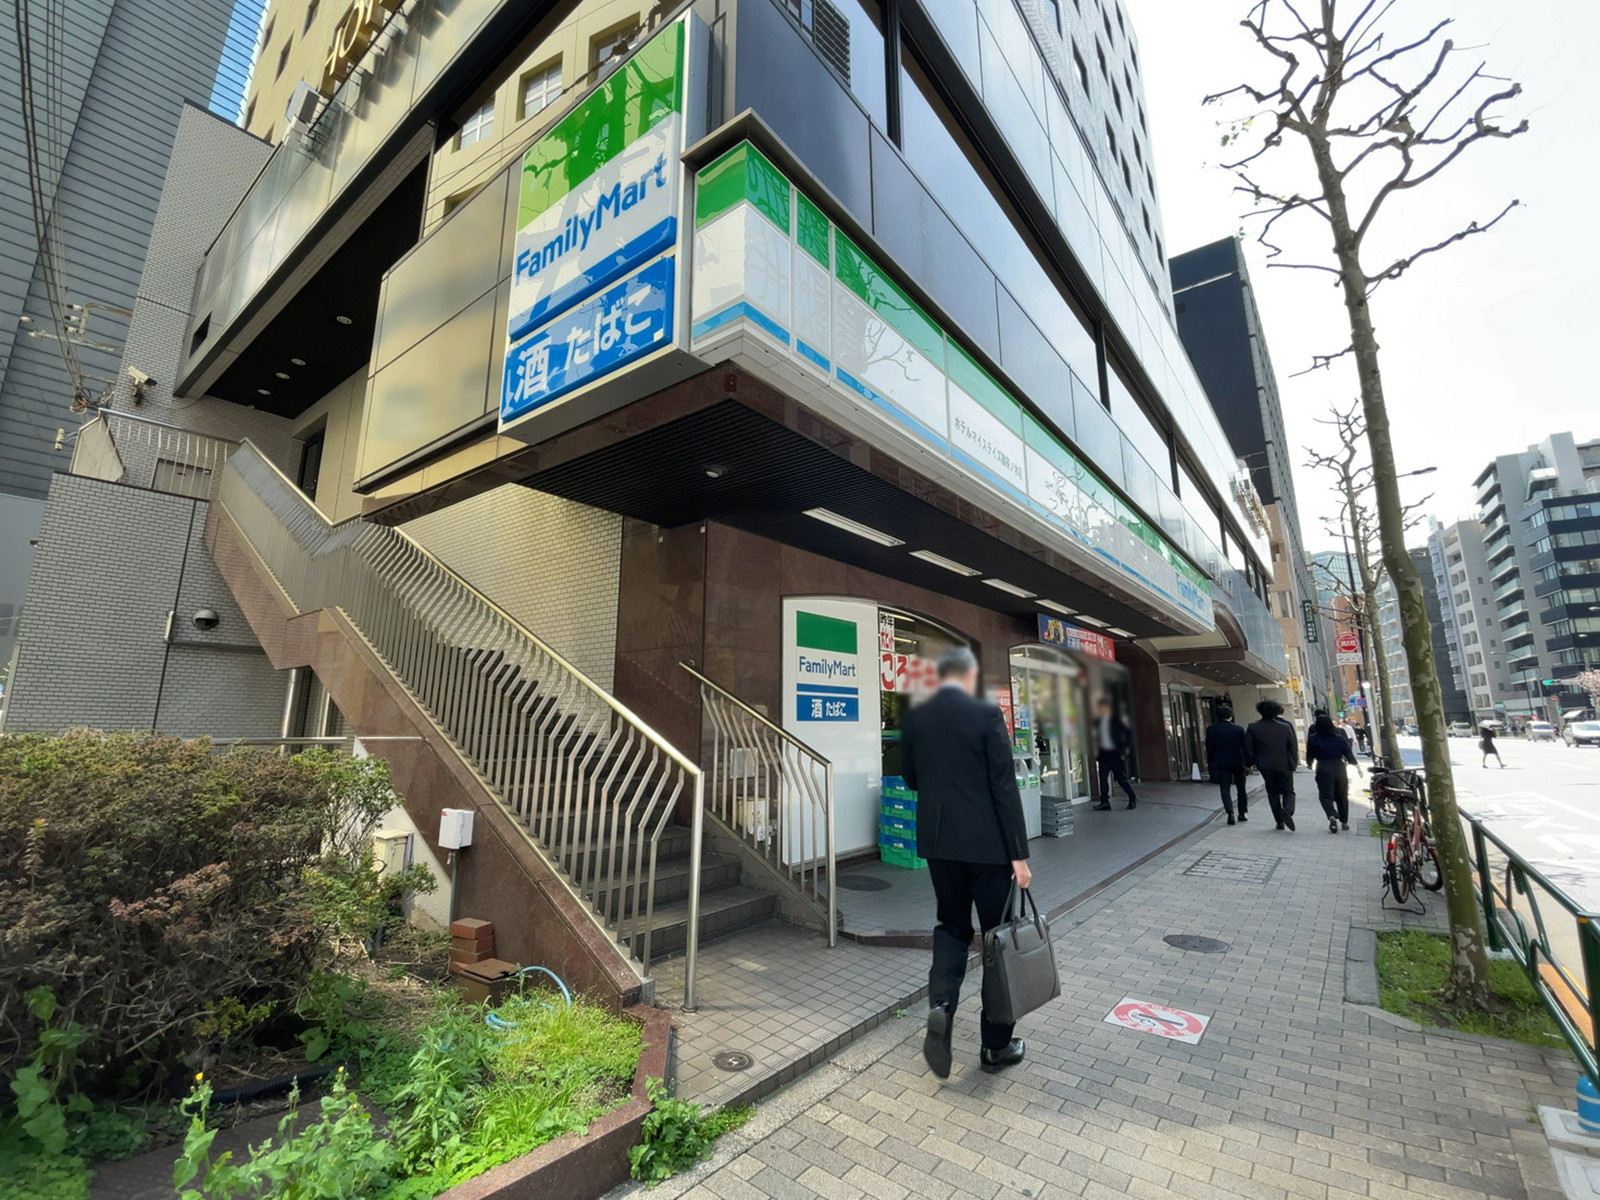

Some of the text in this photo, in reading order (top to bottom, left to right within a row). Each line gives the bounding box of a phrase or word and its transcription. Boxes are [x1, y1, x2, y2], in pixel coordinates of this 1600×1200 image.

[516, 153, 668, 284] FamilyMart
[514, 286, 652, 400] 酒 たばこ
[799, 655, 856, 679] FamilyMart
[811, 698, 847, 718] 酒 たばこ
